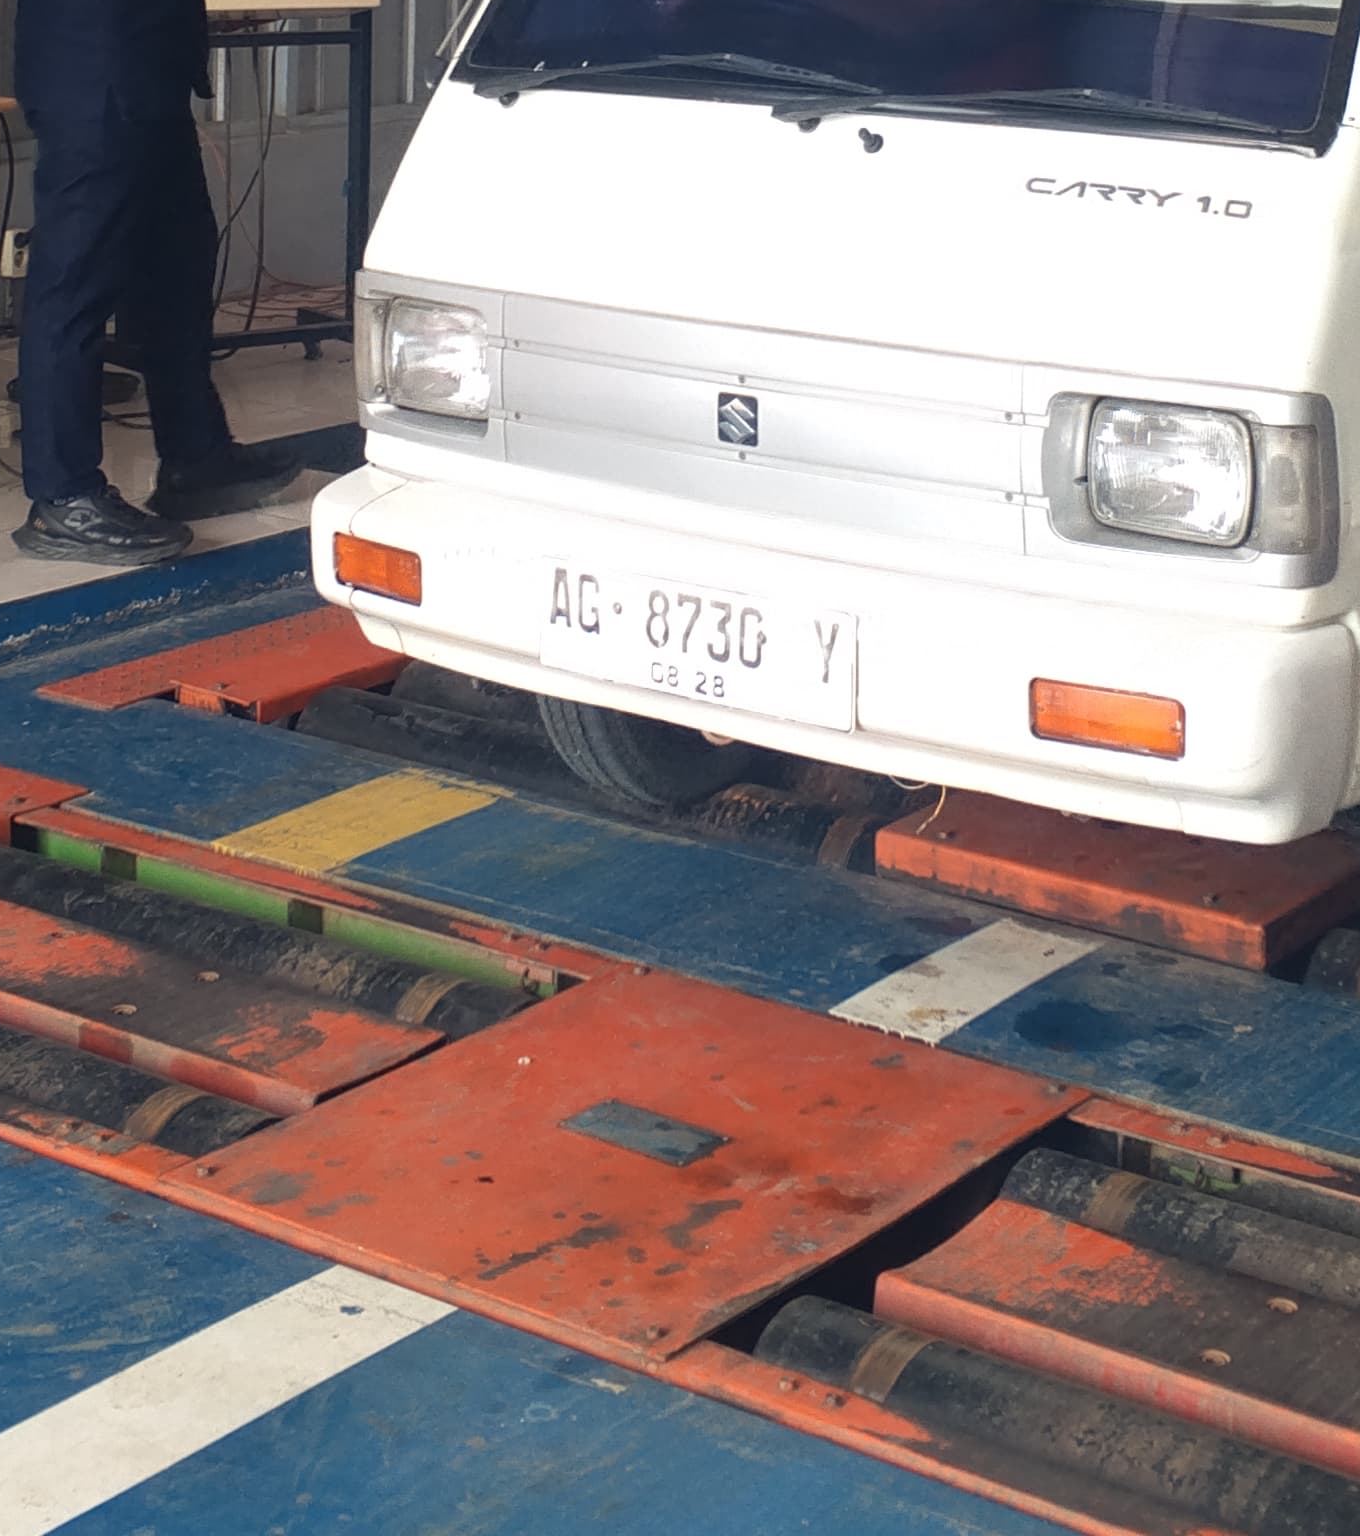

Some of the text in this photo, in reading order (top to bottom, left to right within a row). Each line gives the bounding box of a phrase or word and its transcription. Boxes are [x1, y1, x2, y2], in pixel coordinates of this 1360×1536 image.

[1026, 177, 1252, 219] CARRY 1.0
[550, 568, 600, 635] AG
[814, 619, 840, 684] Y
[651, 662, 725, 698] 08 28
